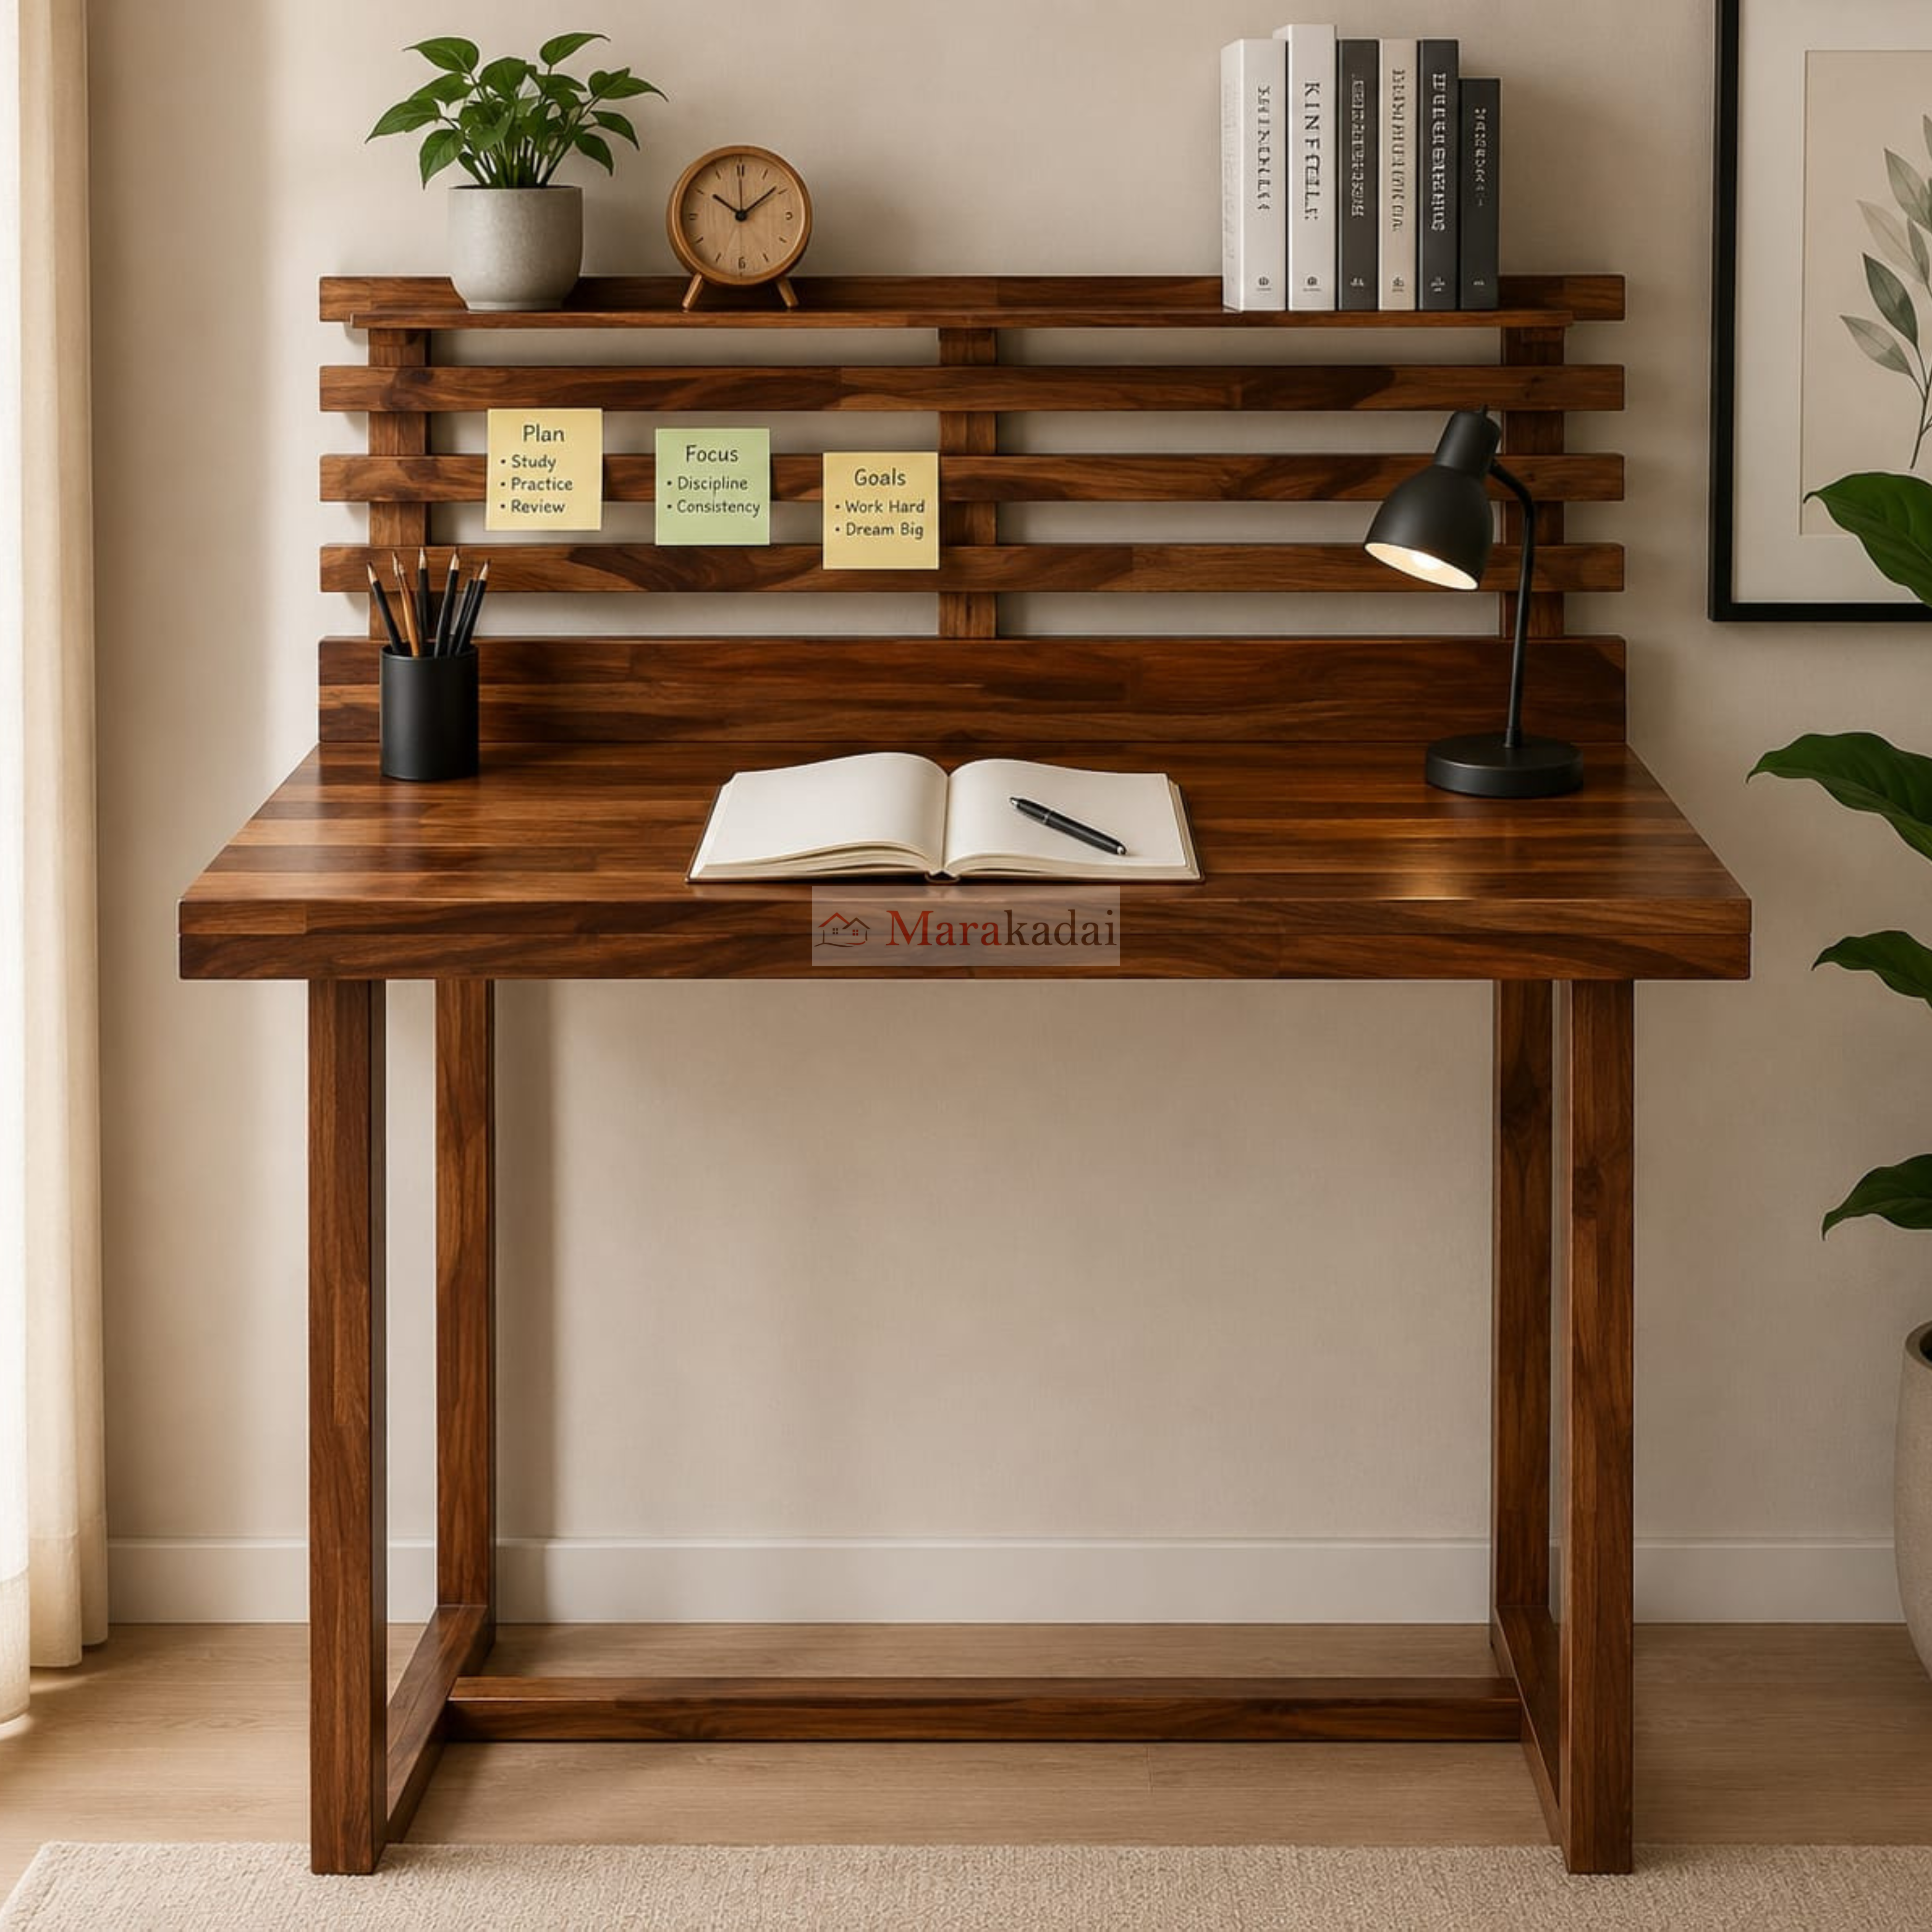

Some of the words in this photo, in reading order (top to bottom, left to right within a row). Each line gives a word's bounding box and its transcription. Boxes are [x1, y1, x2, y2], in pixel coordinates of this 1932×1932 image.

[523, 424, 565, 442] Plan
[686, 444, 739, 462] Focus
[511, 455, 556, 473] Study
[511, 477, 573, 490] Practice
[678, 475, 748, 496] Discipline
[855, 468, 906, 485] Goals
[511, 499, 565, 512] Review
[677, 499, 760, 518] Consistency
[845, 499, 883, 513] Work
[889, 500, 924, 513] Hard
[846, 522, 894, 536] Dream
[901, 522, 923, 540] Big
